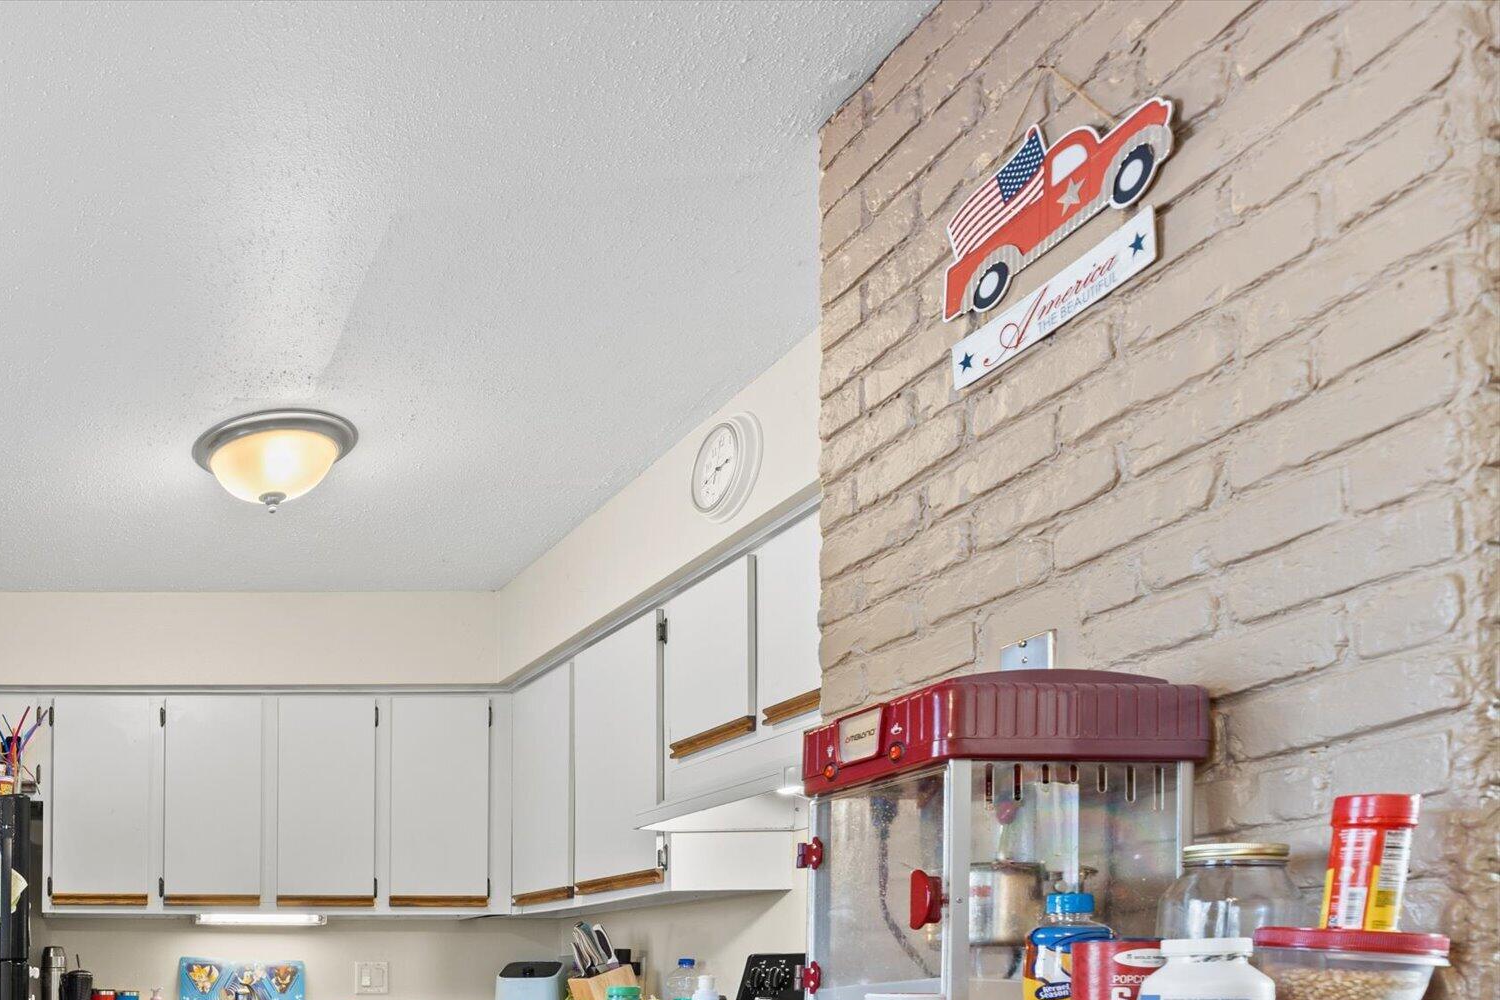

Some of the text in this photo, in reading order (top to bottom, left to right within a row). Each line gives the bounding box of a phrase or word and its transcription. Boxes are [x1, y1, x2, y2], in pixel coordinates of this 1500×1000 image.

[983, 254, 1117, 367] America
[1037, 271, 1118, 336] THE BEAUTIFUL
[1043, 983, 1070, 993] Kernel
[1112, 974, 1145, 984] POPCO
